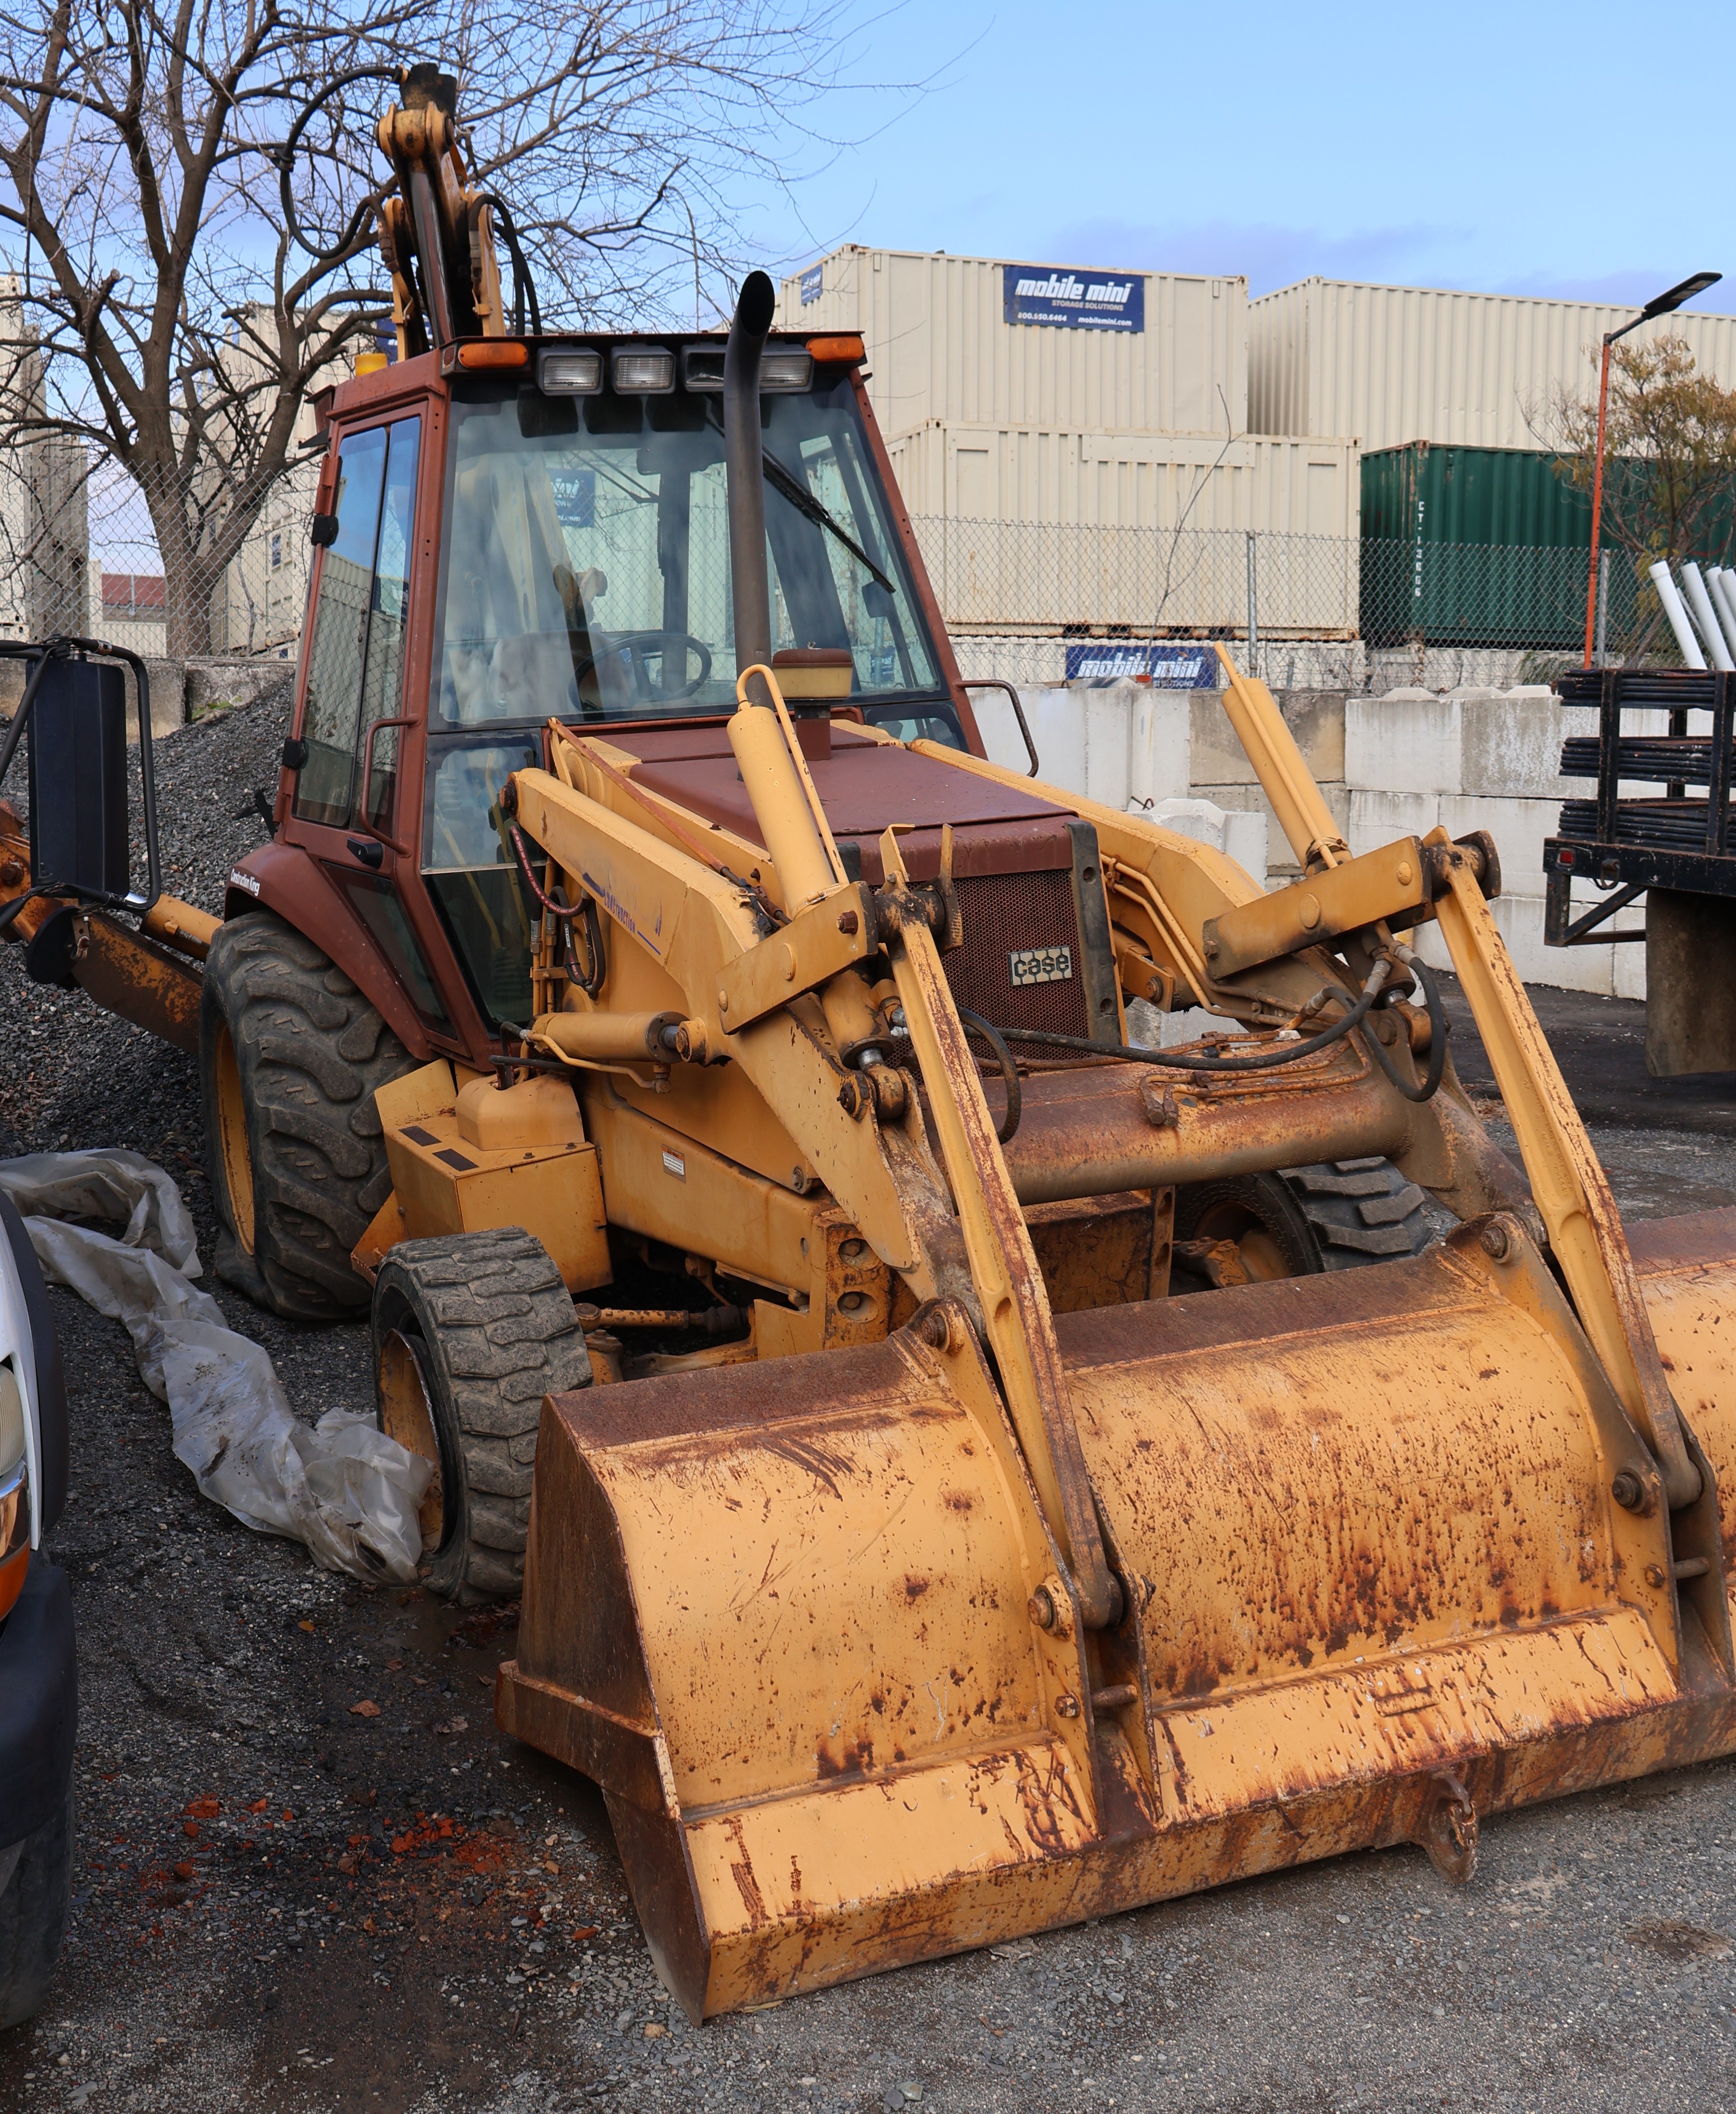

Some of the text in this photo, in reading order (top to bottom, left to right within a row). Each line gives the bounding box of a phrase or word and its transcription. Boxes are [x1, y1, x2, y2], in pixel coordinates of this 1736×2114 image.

[1015, 274, 1132, 303] mobile mini
[1051, 299, 1124, 311] STORAGE SOLUTIONS
[1078, 316, 1132, 326] mobilemini.com
[249, 876, 260, 896] King
[1013, 954, 1070, 978] case
